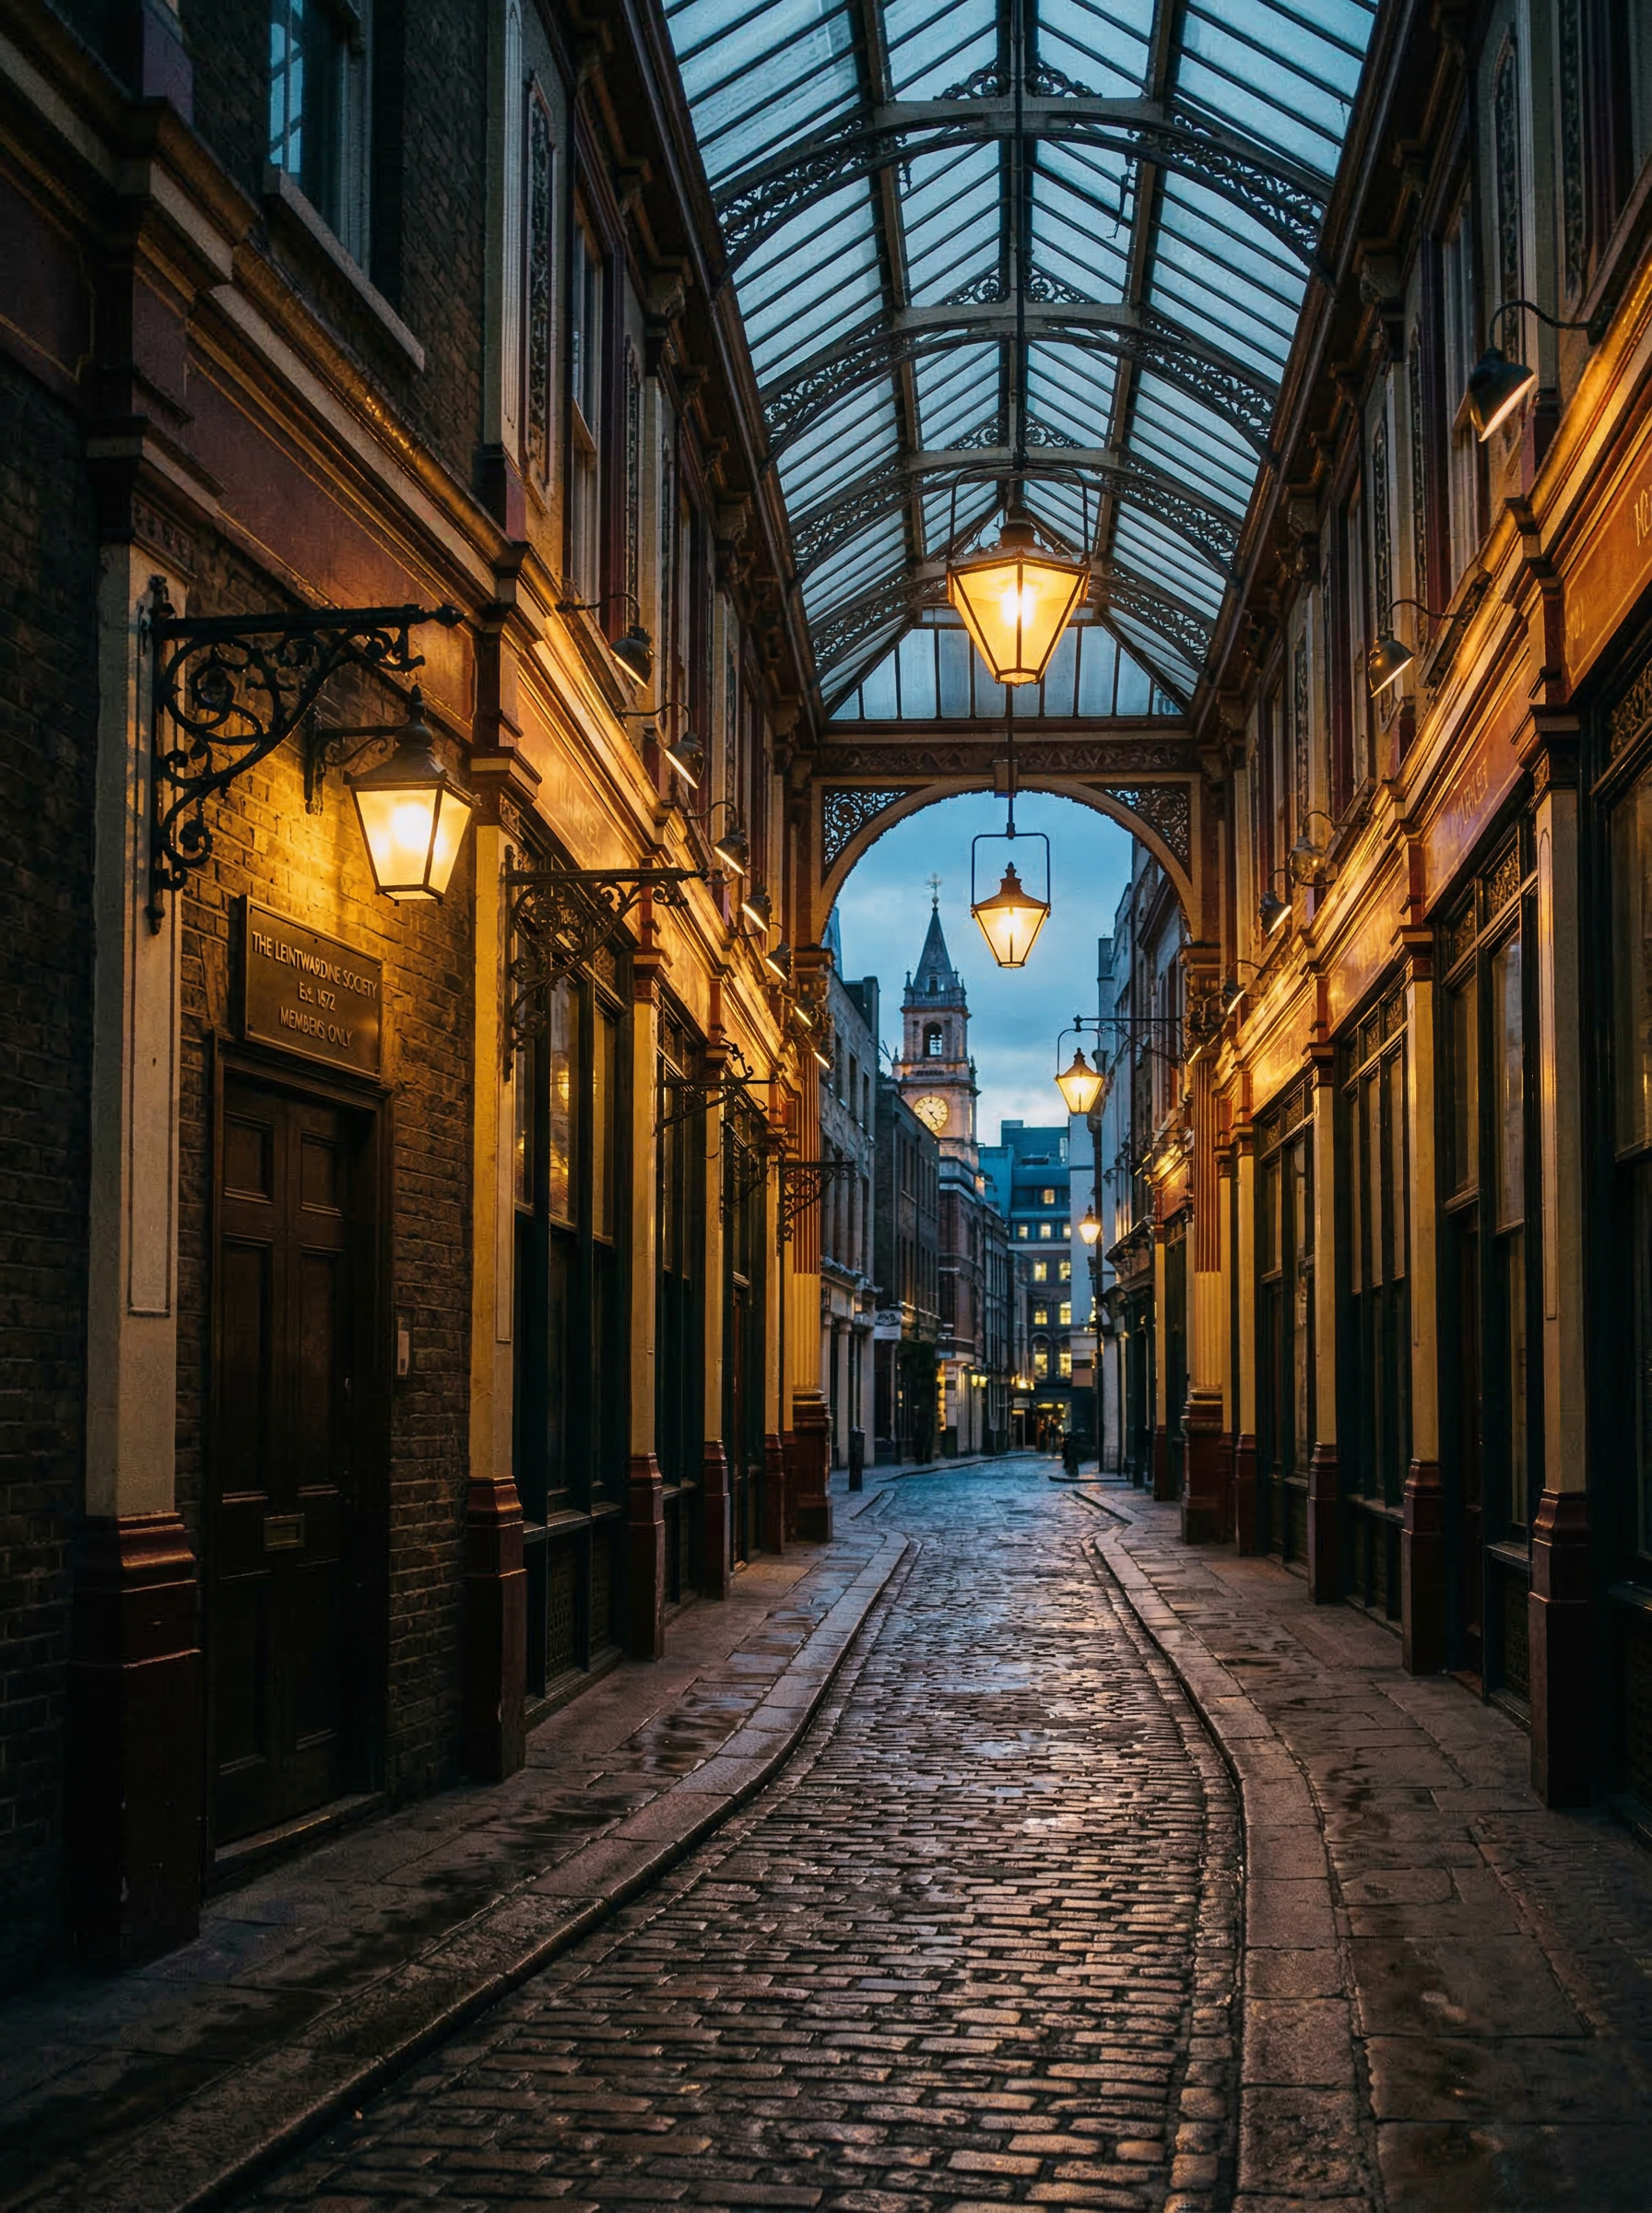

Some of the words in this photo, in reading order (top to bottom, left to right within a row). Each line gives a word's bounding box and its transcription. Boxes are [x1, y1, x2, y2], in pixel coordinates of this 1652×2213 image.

[252, 930, 272, 957] THE
[342, 969, 377, 1000] SOCIETY
[328, 1024, 353, 1047] ONLY
